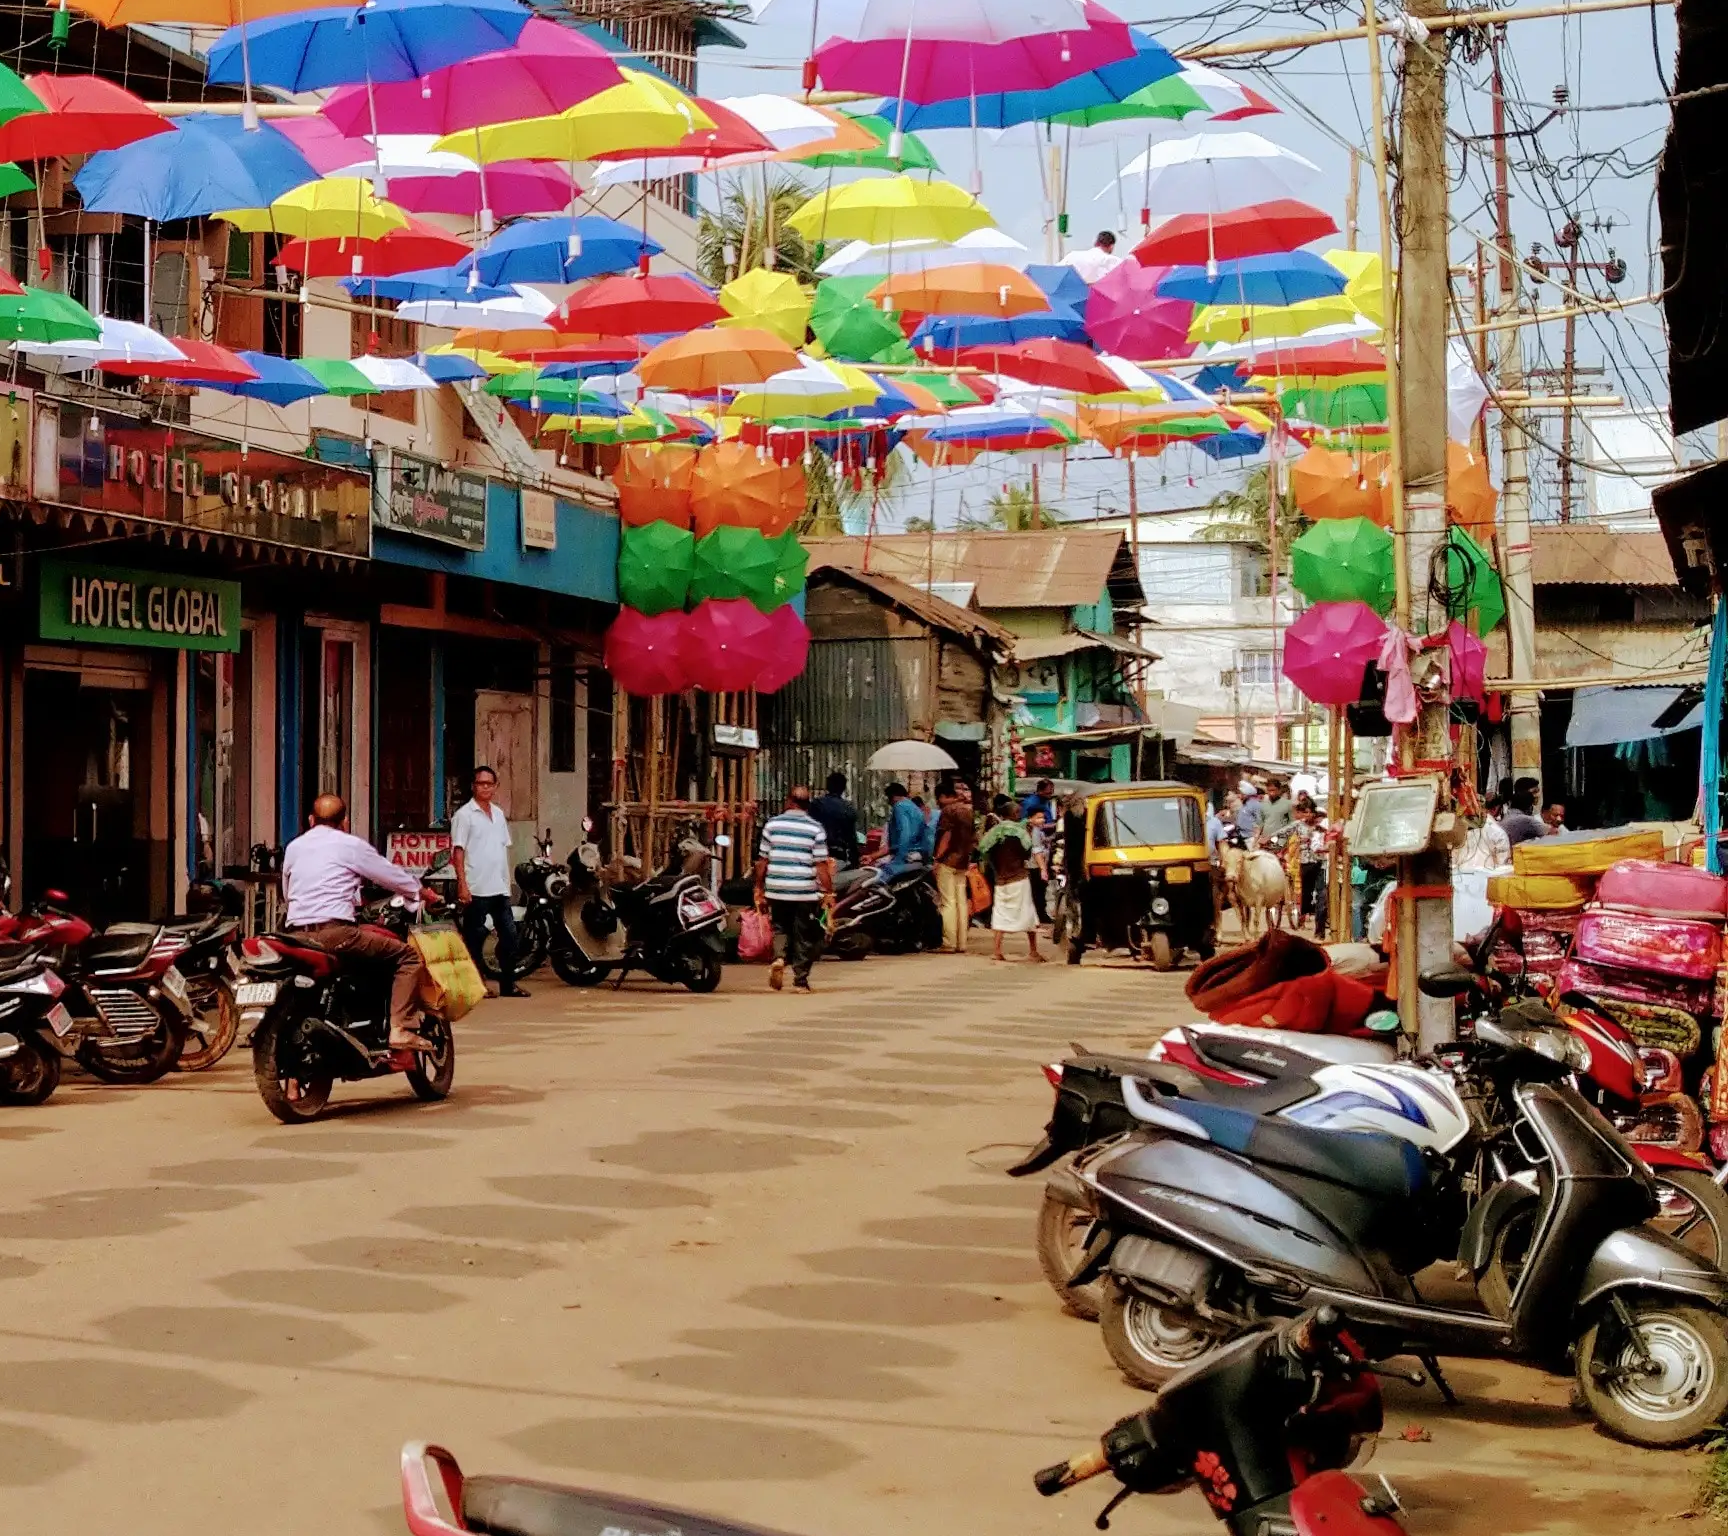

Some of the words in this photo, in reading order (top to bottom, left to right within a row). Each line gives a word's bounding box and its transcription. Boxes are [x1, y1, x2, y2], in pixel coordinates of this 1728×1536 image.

[109, 444, 205, 497] HOTEL
[222, 472, 321, 521] GLOBAL
[71, 576, 143, 630] HOTEL
[147, 584, 228, 637] GLOBAL
